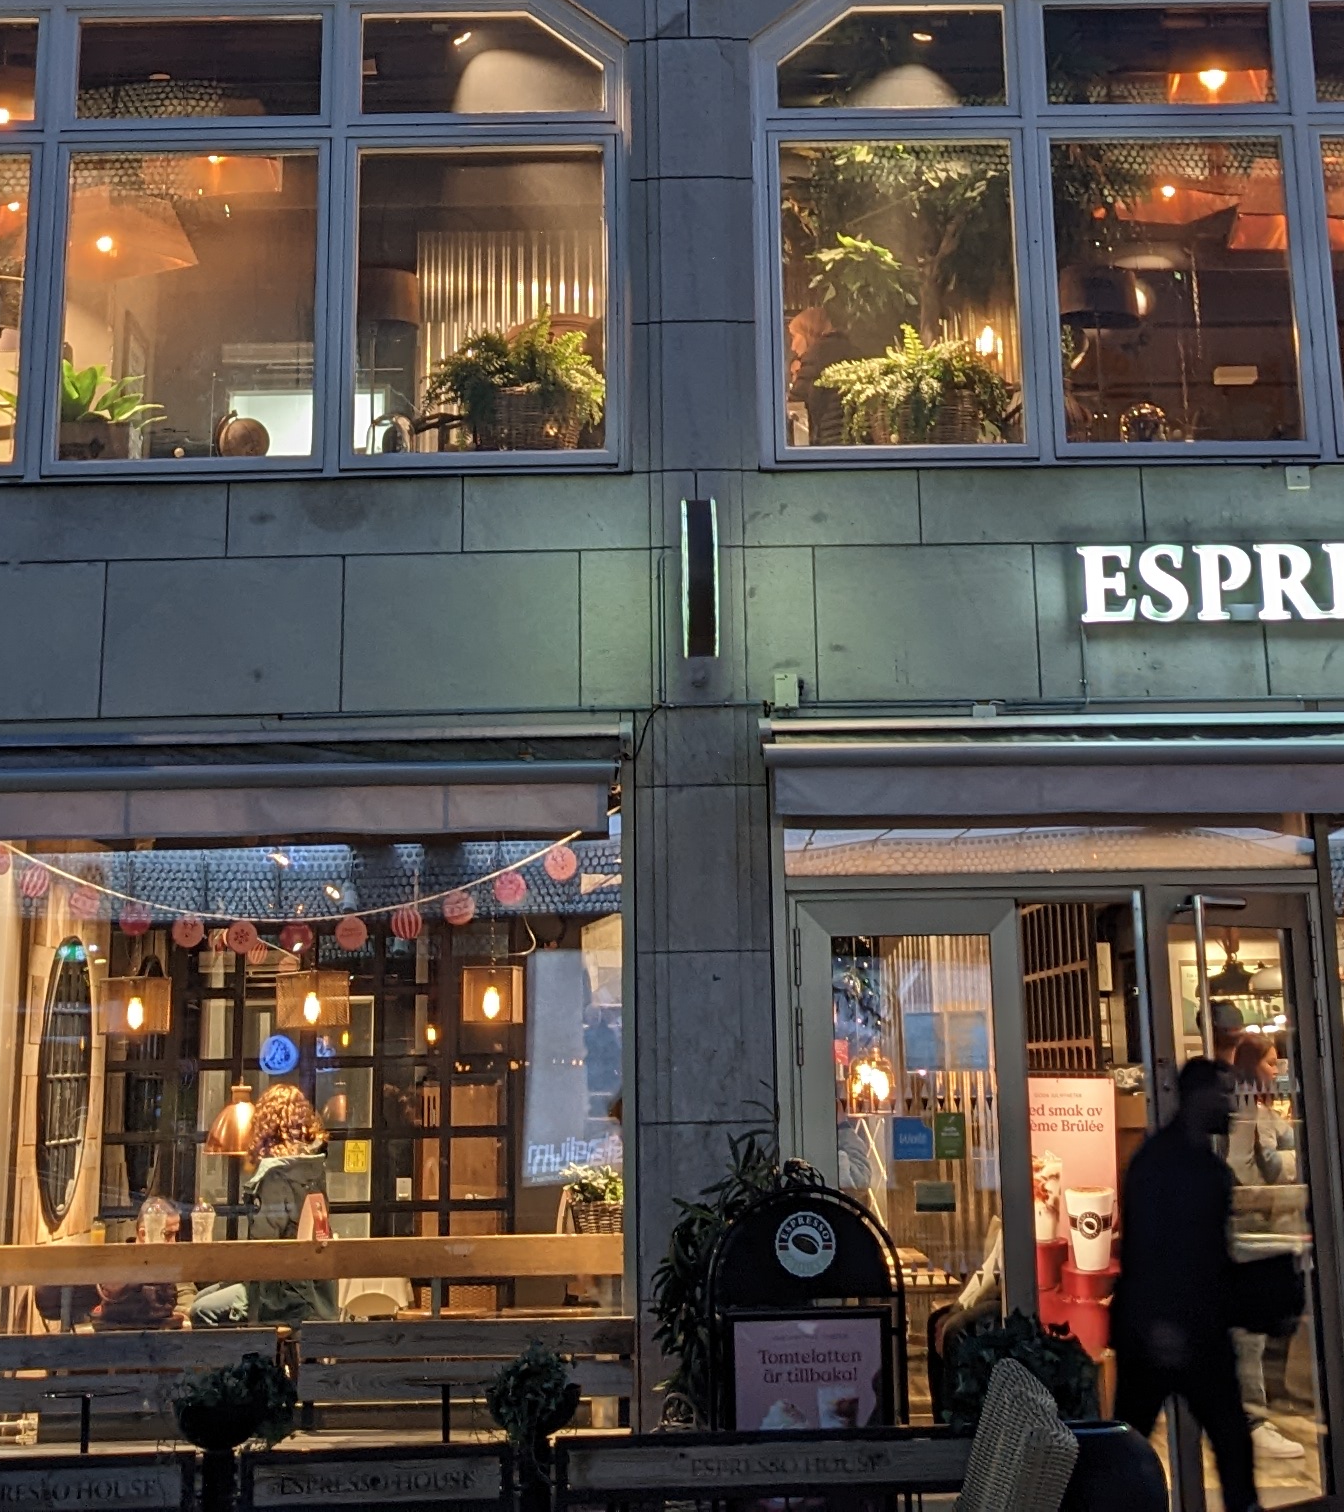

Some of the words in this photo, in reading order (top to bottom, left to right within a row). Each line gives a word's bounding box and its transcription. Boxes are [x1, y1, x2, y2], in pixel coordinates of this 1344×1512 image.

[1029, 1103, 1046, 1117] ed
[1048, 1103, 1084, 1117] smak
[1086, 1107, 1103, 1117] av
[1030, 1119, 1058, 1132] ème
[1061, 1119, 1104, 1132] Brûlée
[779, 1215, 830, 1240] ESPRESSO
[758, 1349, 862, 1366] Tomtelatten
[763, 1368, 783, 1384] är
[787, 1366, 858, 1384] tillbaka!
[76, 1477, 155, 1500] HOUSE
